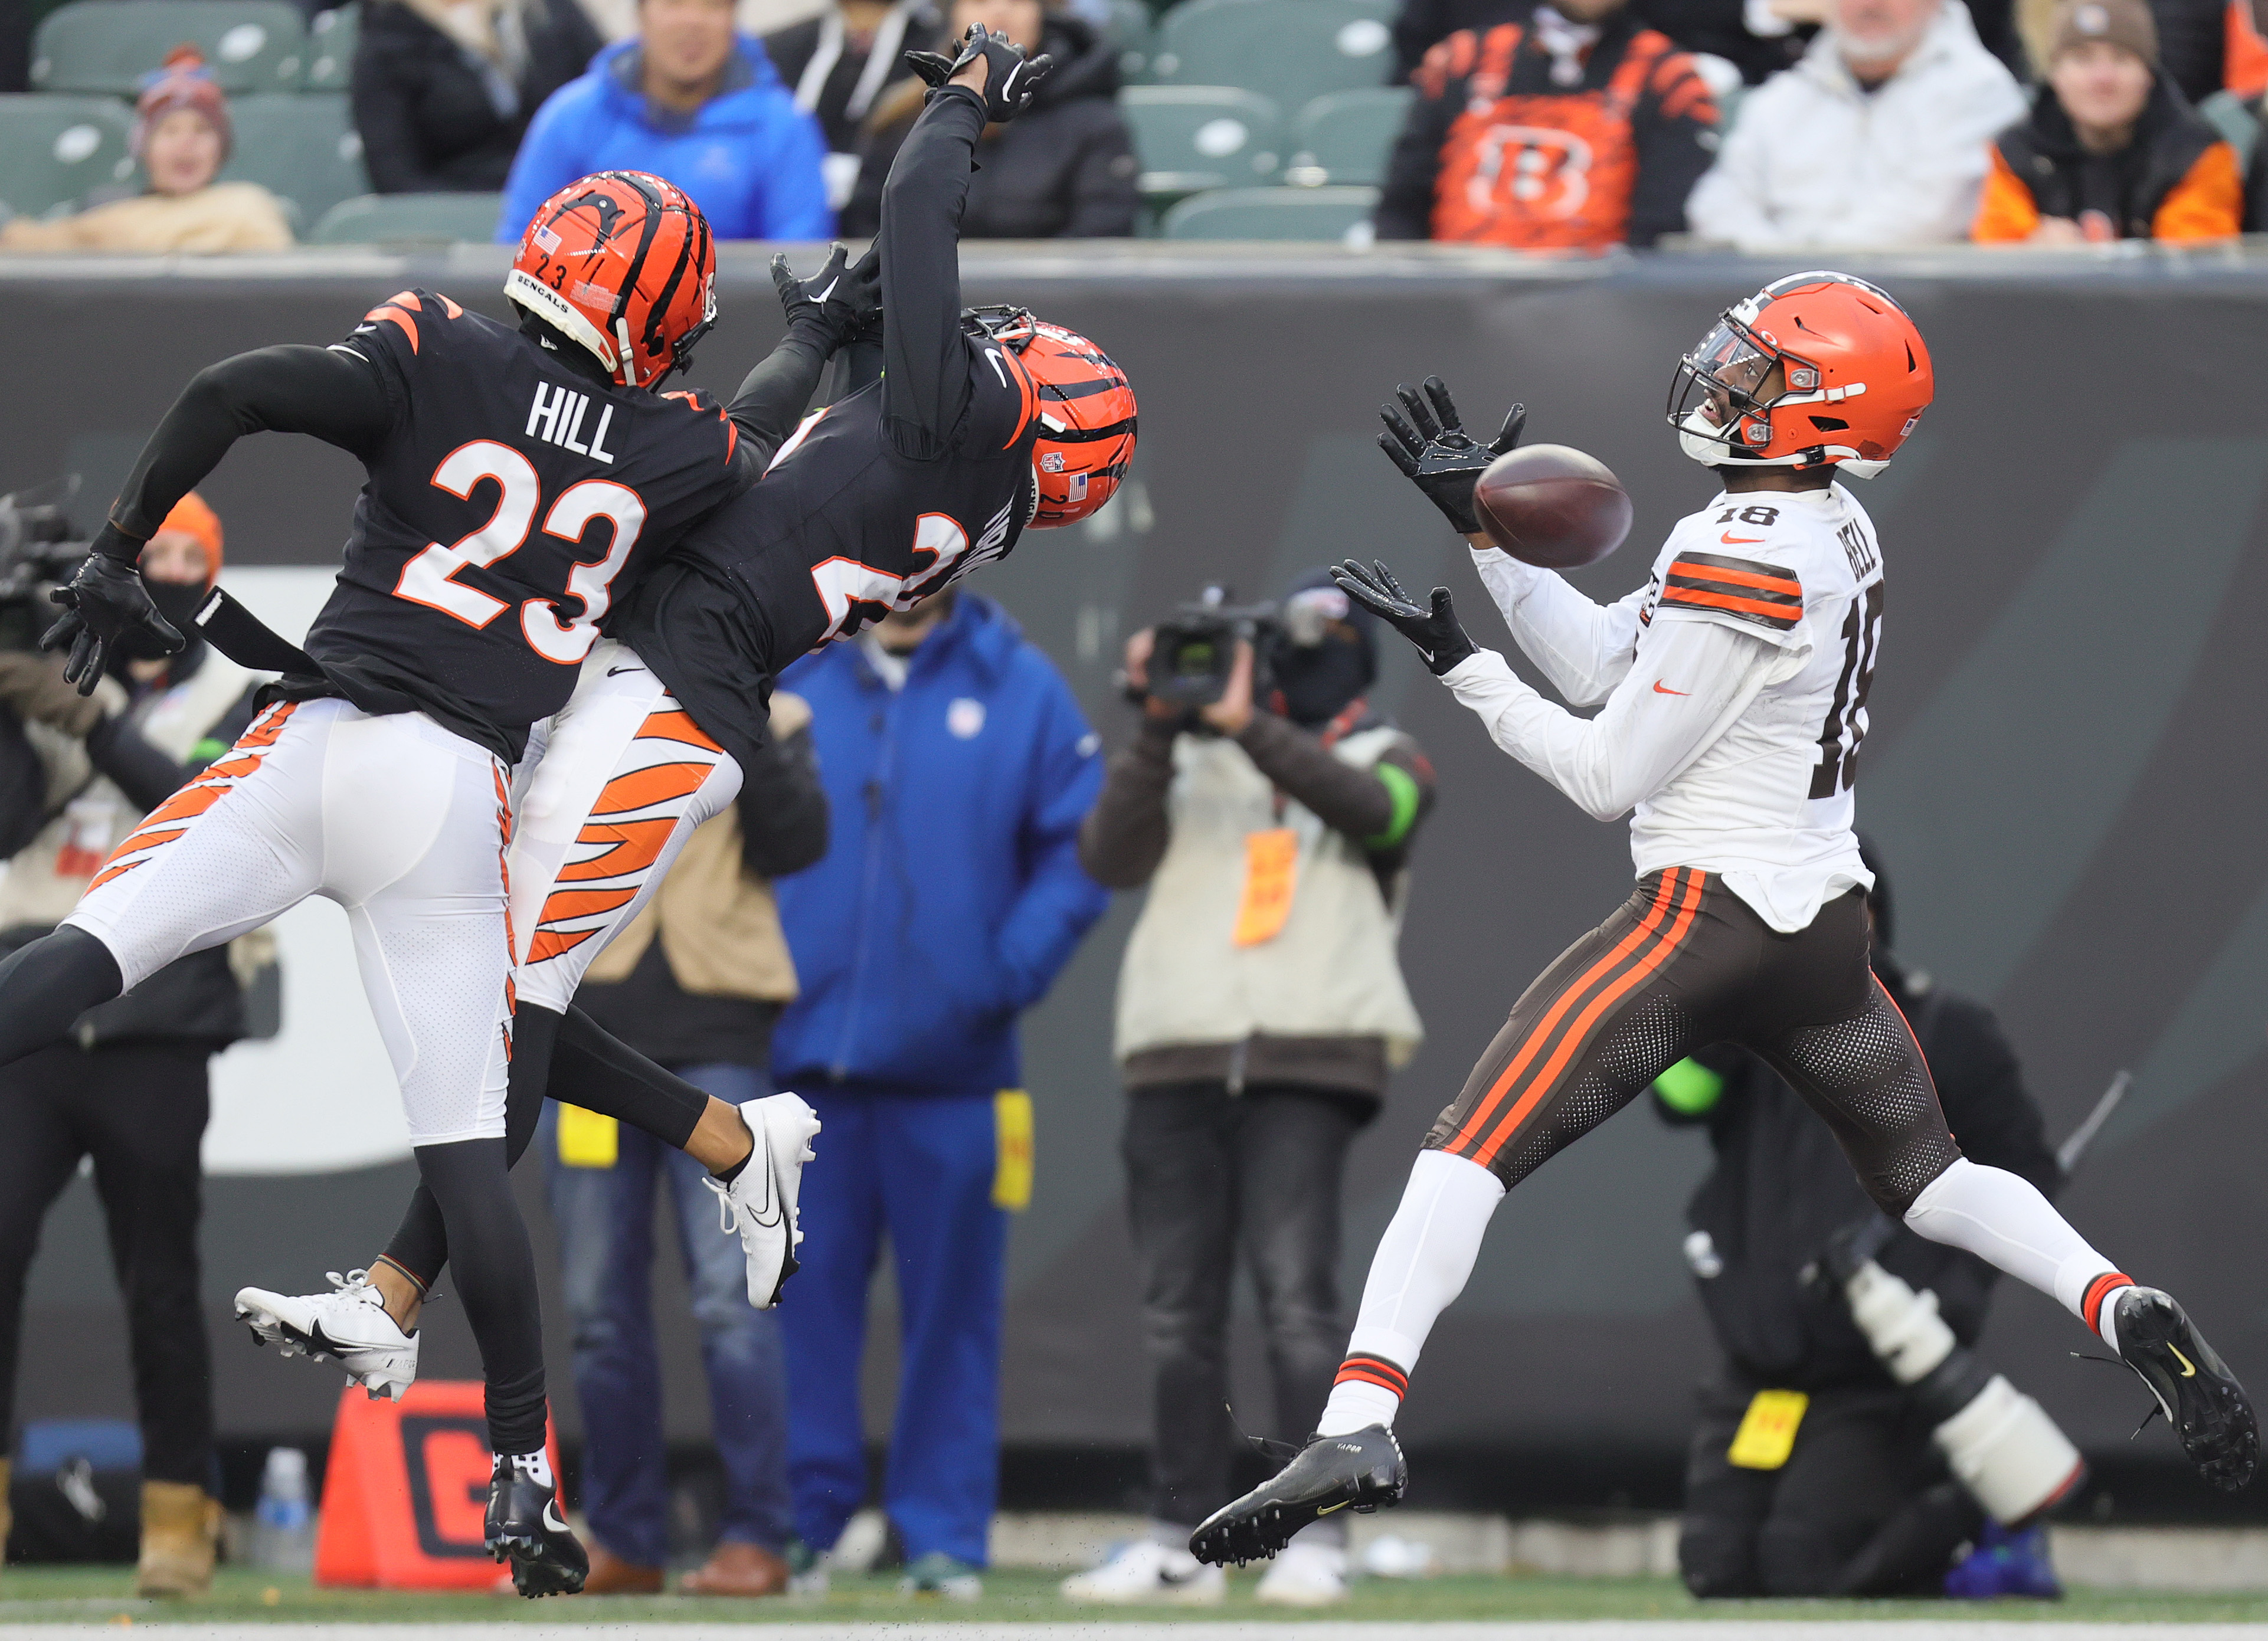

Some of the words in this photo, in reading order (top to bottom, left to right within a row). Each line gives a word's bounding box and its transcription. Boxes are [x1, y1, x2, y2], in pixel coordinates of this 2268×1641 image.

[535, 253, 567, 290] 23
[518, 275, 569, 313] BENGALS
[525, 381, 614, 464] HILL
[1044, 456, 1055, 470] NFL
[1039, 494, 1067, 519] 20
[1714, 506, 1780, 526] 18
[392, 439, 647, 665] 23
[1337, 1442, 1362, 1453] VAPOR
